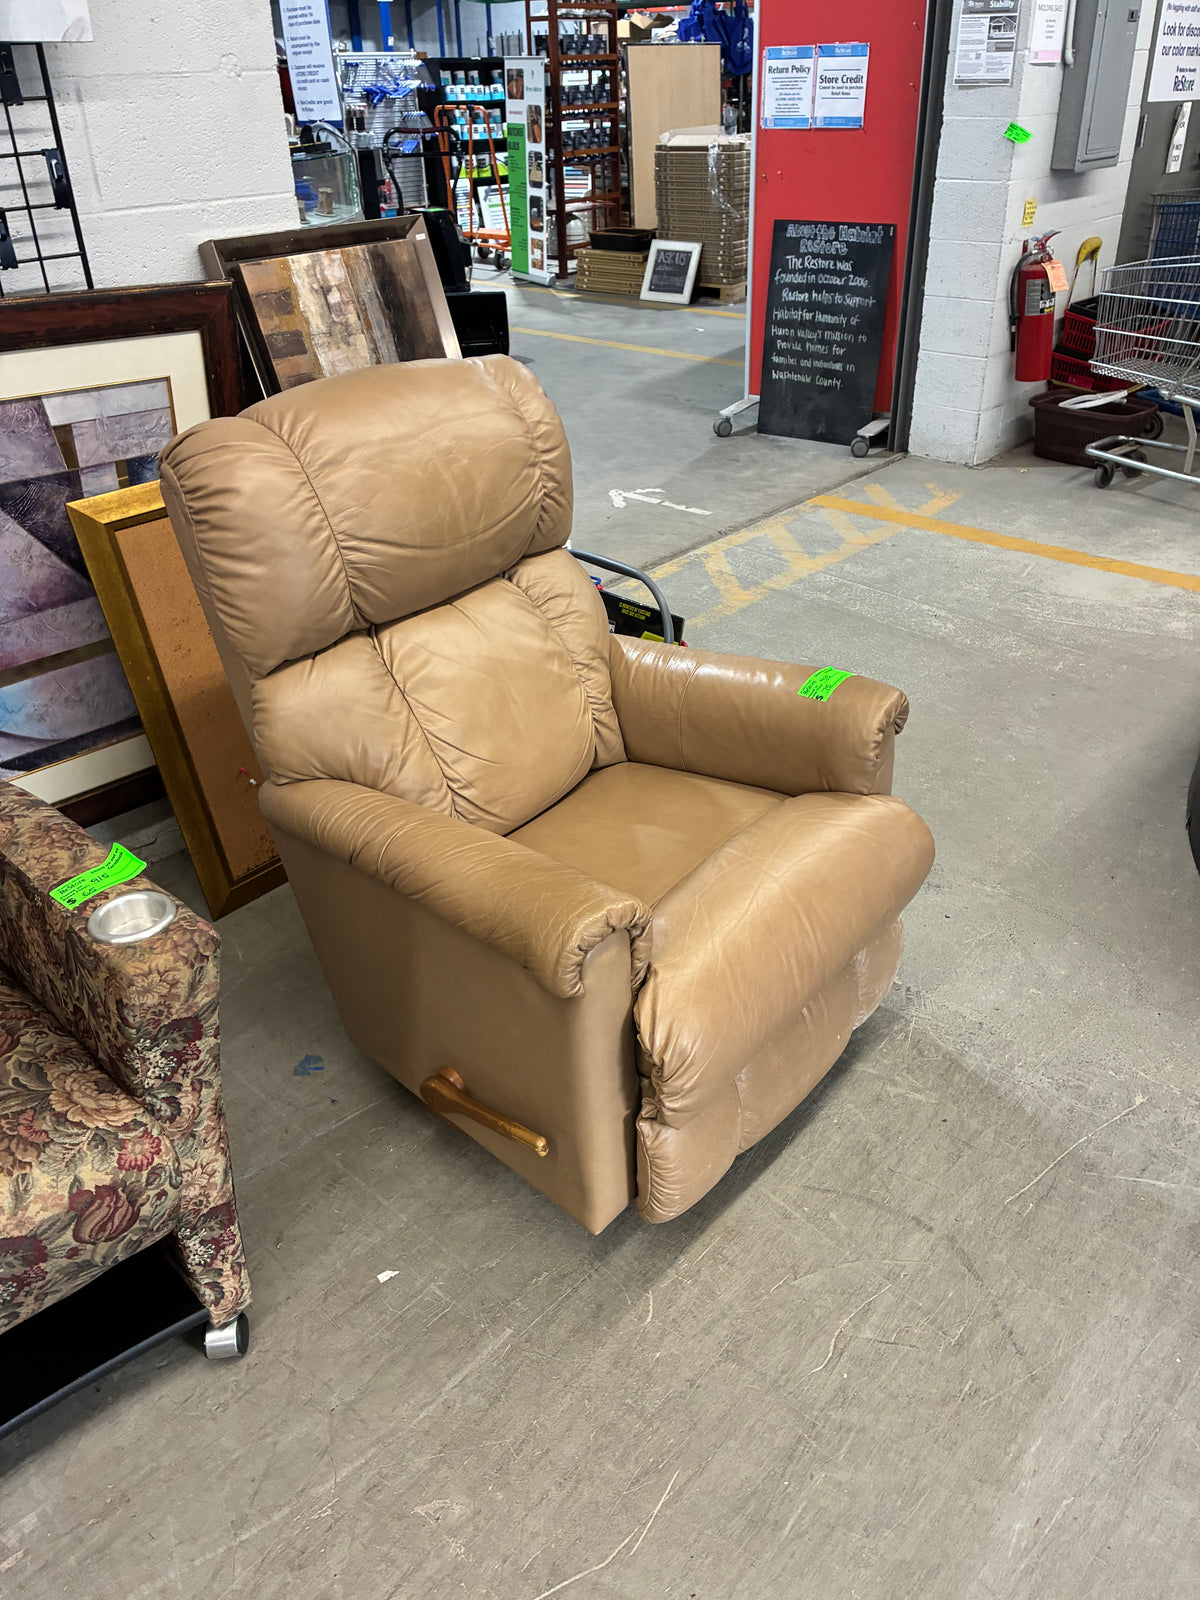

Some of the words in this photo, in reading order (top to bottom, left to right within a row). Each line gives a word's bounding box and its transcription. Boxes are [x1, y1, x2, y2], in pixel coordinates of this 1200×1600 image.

[989, 0, 1015, 9] Stability
[1162, 21, 1177, 36] Look
[1177, 22, 1186, 37] for
[1161, 45, 1172, 56] our
[1172, 43, 1186, 56] color
[768, 65, 789, 74] Return
[791, 64, 811, 75] Policy
[819, 74, 839, 84] Store
[841, 74, 864, 84] Credit
[1173, 75, 1195, 92] ReStore
[839, 225, 884, 244] Habitat
[785, 255, 803, 270] The
[774, 268, 807, 285] founded
[808, 272, 816, 284] in
[812, 289, 834, 304] helps
[834, 292, 843, 304] to
[773, 306, 802, 321] Habitat
[802, 309, 815, 321] for
[815, 311, 848, 328] Humanity
[850, 314, 861, 326] of
[771, 324, 795, 337] Huron
[824, 330, 854, 343] mission
[858, 334, 867, 343] to
[832, 343, 846, 356] for
[771, 352, 797, 365] families
[800, 357, 812, 368] and
[846, 363, 856, 372] in
